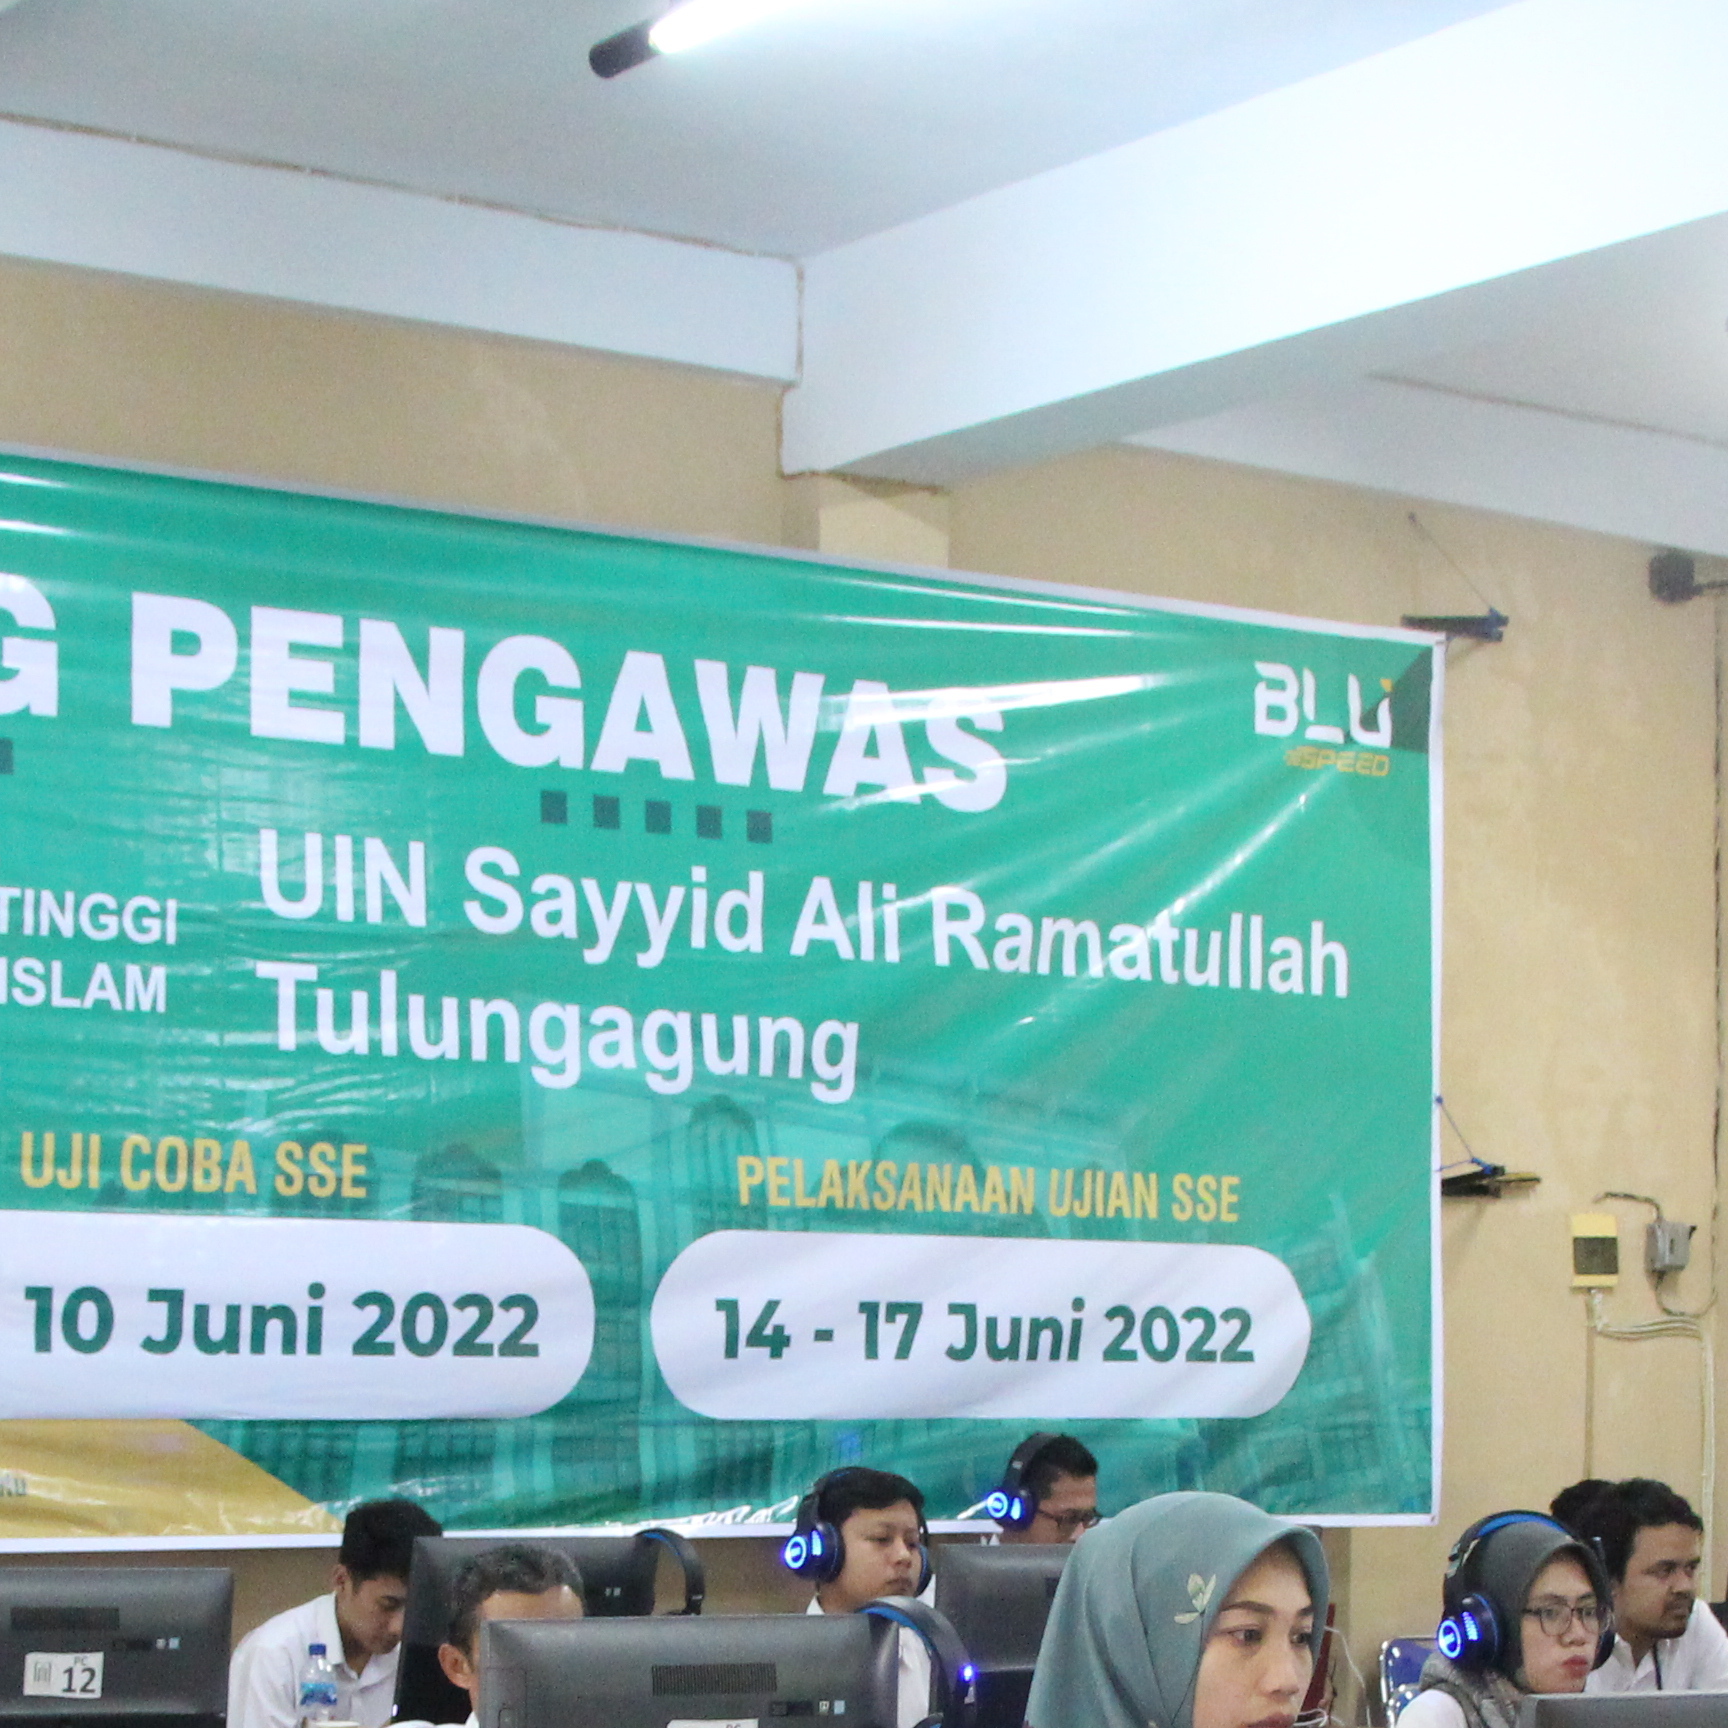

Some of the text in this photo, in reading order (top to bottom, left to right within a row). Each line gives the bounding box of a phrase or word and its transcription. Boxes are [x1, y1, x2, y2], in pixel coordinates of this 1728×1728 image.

[129, 590, 1010, 813] PENGAWAS
[1254, 661, 1393, 749] BLU
[258, 828, 1351, 999] UIN Sayyid Ali Ramatullah
[255, 962, 860, 1104] Tulungagung
[21, 1131, 369, 1199] UJI COBA SSE
[736, 1155, 1241, 1224] PELAKSANAAN UJIAN SSE
[23, 1285, 114, 1356] 10
[140, 1282, 328, 1357] Juni
[351, 1292, 541, 1359] 2022
[715, 1298, 791, 1361] 14
[858, 1300, 924, 1361] 17
[945, 1297, 1087, 1363] Juni
[1102, 1304, 1256, 1364] 2022
[62, 1666, 97, 1694] 12
